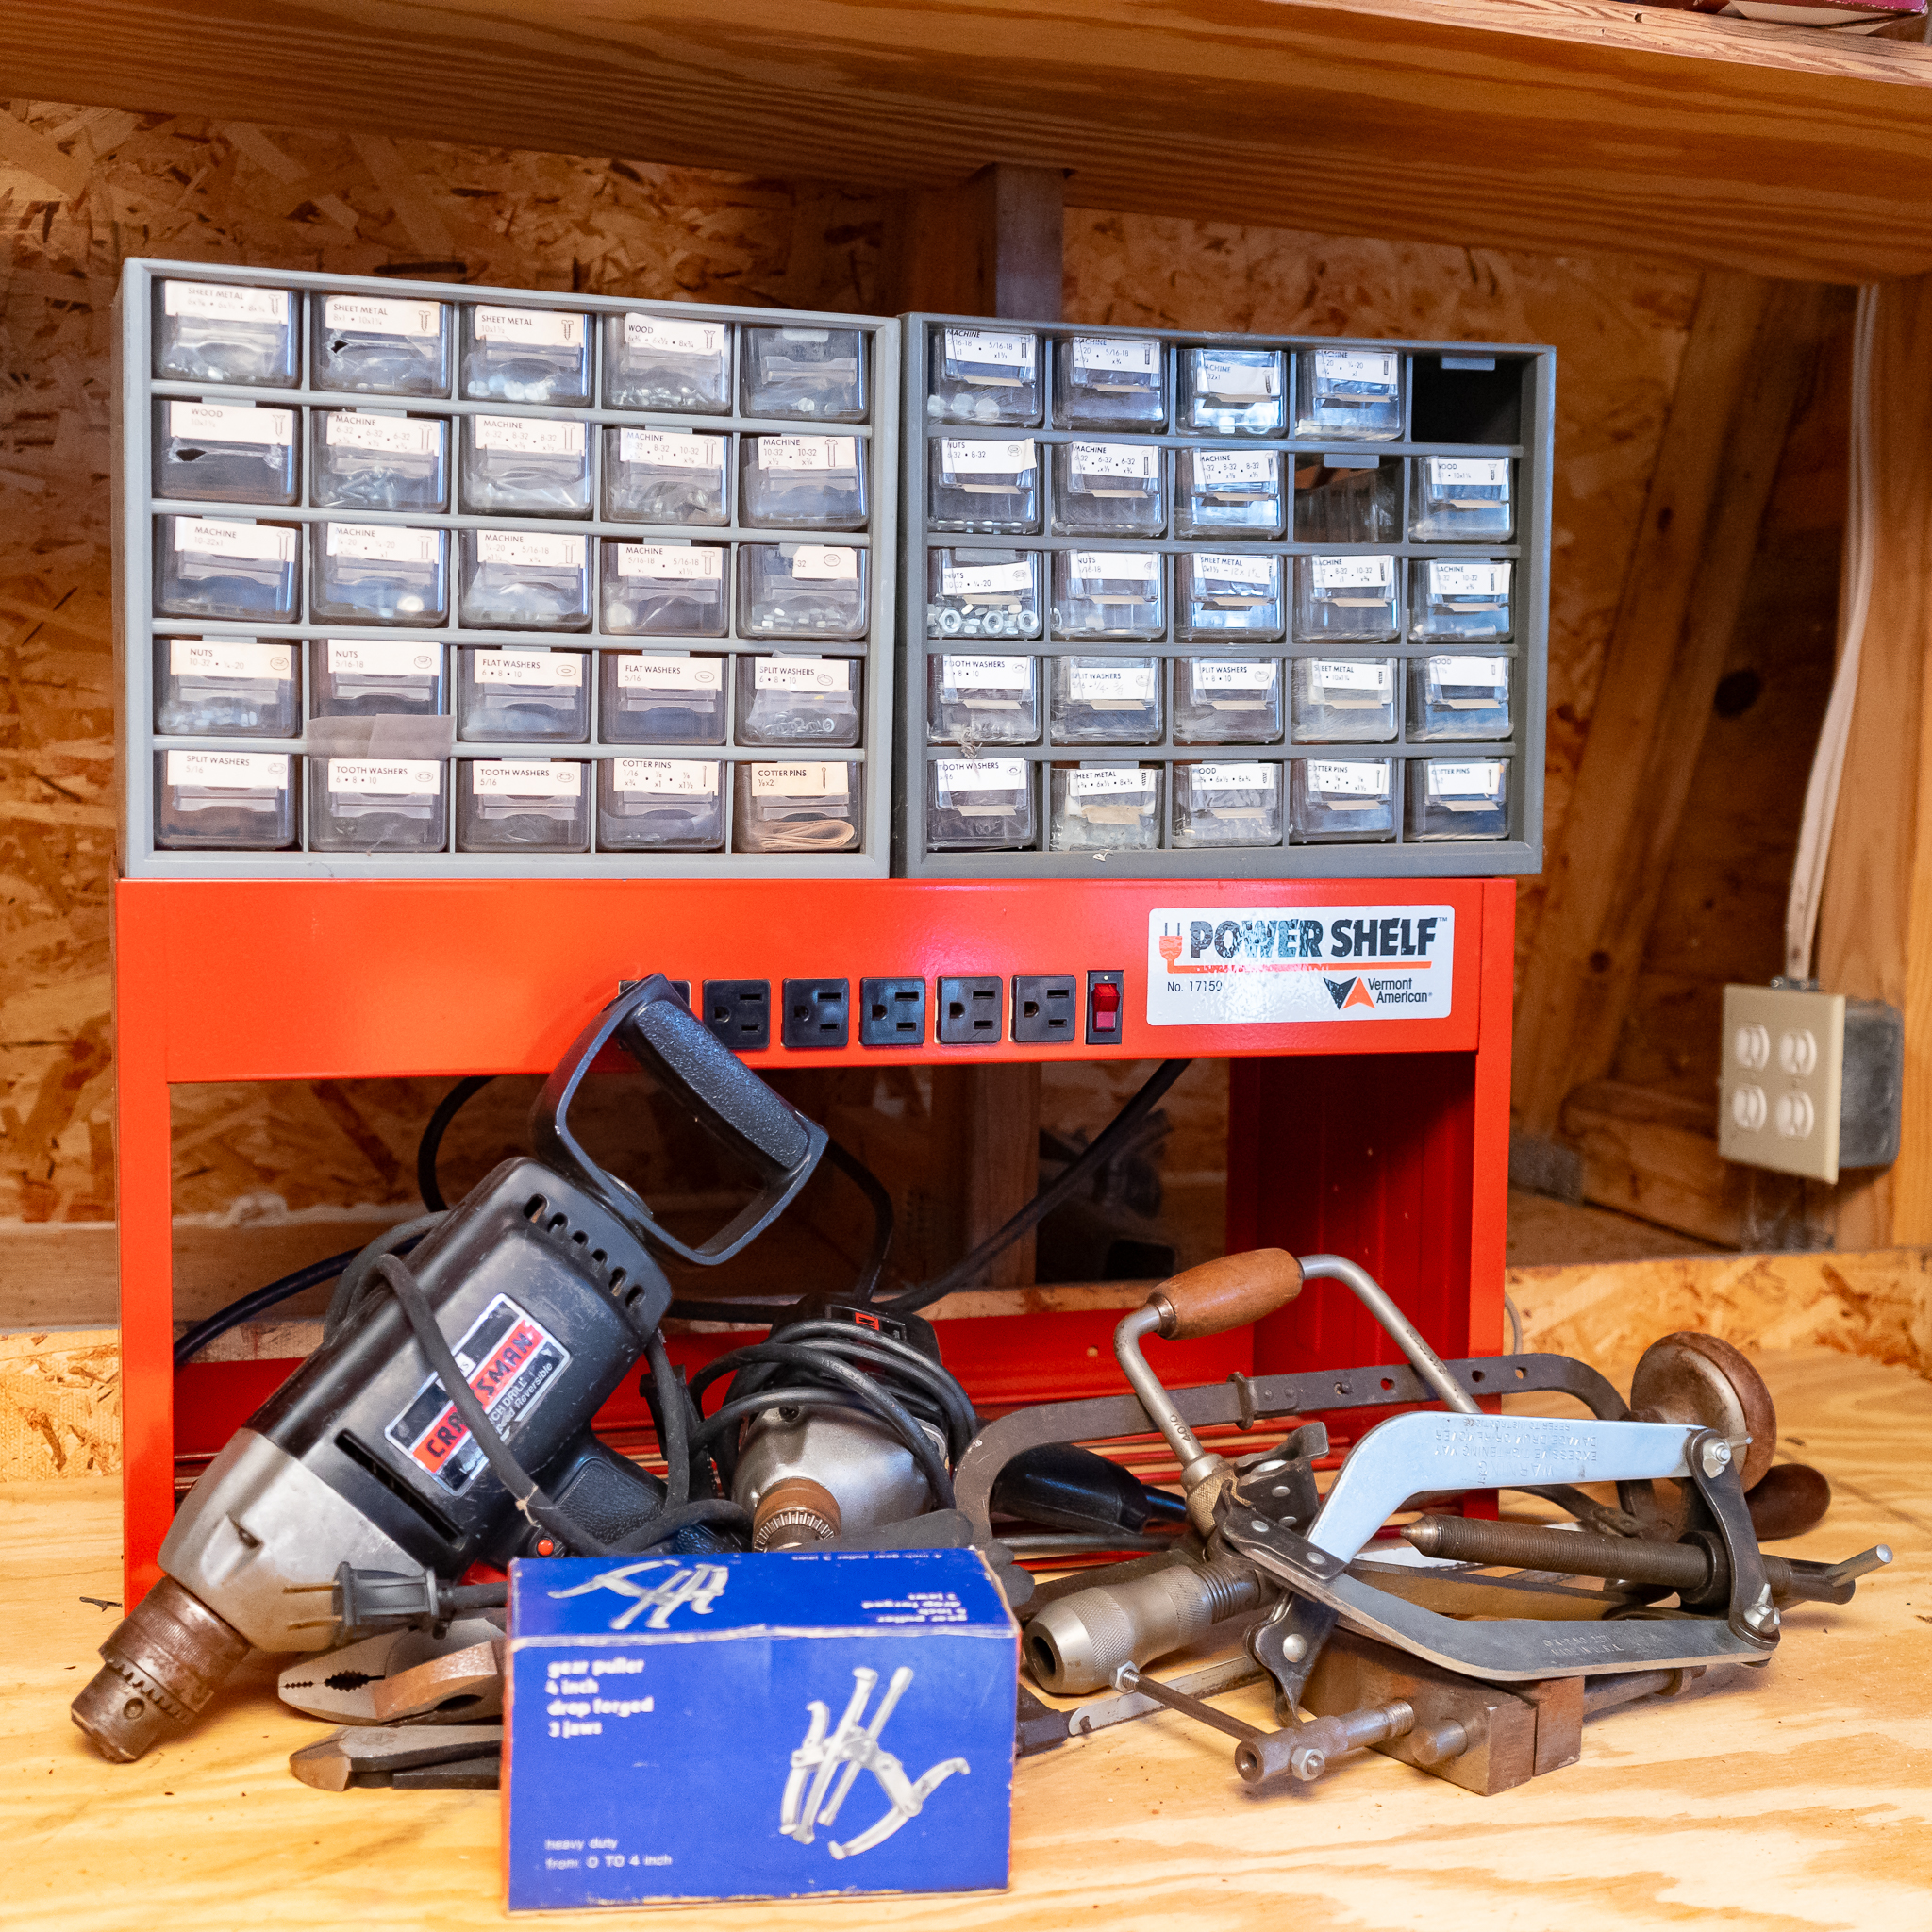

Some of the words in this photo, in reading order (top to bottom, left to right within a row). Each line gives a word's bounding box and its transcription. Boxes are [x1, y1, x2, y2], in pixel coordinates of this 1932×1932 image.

[189, 288, 213, 297] SHEET
[216, 291, 243, 300] METAL
[334, 304, 358, 312] SHEET
[360, 307, 388, 315] METAL
[482, 315, 505, 324] SHEET
[508, 317, 533, 325] METAL
[628, 325, 653, 333] WOOD
[192, 408, 223, 417] WOOD
[336, 415, 375, 425] MACHINE
[483, 420, 522, 428] MACHINE
[626, 432, 663, 441] MACHINE
[195, 526, 236, 538] MACHINE
[336, 527, 375, 537] MACHINE
[503, 660, 540, 669] WASHERS
[780, 667, 814, 675] WASHERS
[210, 758, 249, 766] WASHERS
[1190, 919, 1323, 958] POWER
[1331, 917, 1437, 958] SHELF
[1167, 981, 1183, 991] No.
[1368, 978, 1412, 990] Vermont
[514, 1362, 553, 1408] Reversible
[426, 1332, 533, 1457] CRASMAN
[502, 1379, 528, 1410] DRILL
[547, 1661, 589, 1679] gear
[592, 1657, 645, 1677] puller
[545, 1680, 558, 1695] 4
[561, 1678, 599, 1695] inch
[547, 1700, 591, 1718] drop
[592, 1695, 654, 1717] forged
[548, 1721, 560, 1738] 3
[562, 1719, 603, 1739] jaws
[544, 1839, 585, 1851] heavy
[588, 1838, 619, 1851] duty
[605, 1855, 626, 1867] TO
[628, 1855, 640, 1866] 4
[643, 1854, 673, 1866] inch
